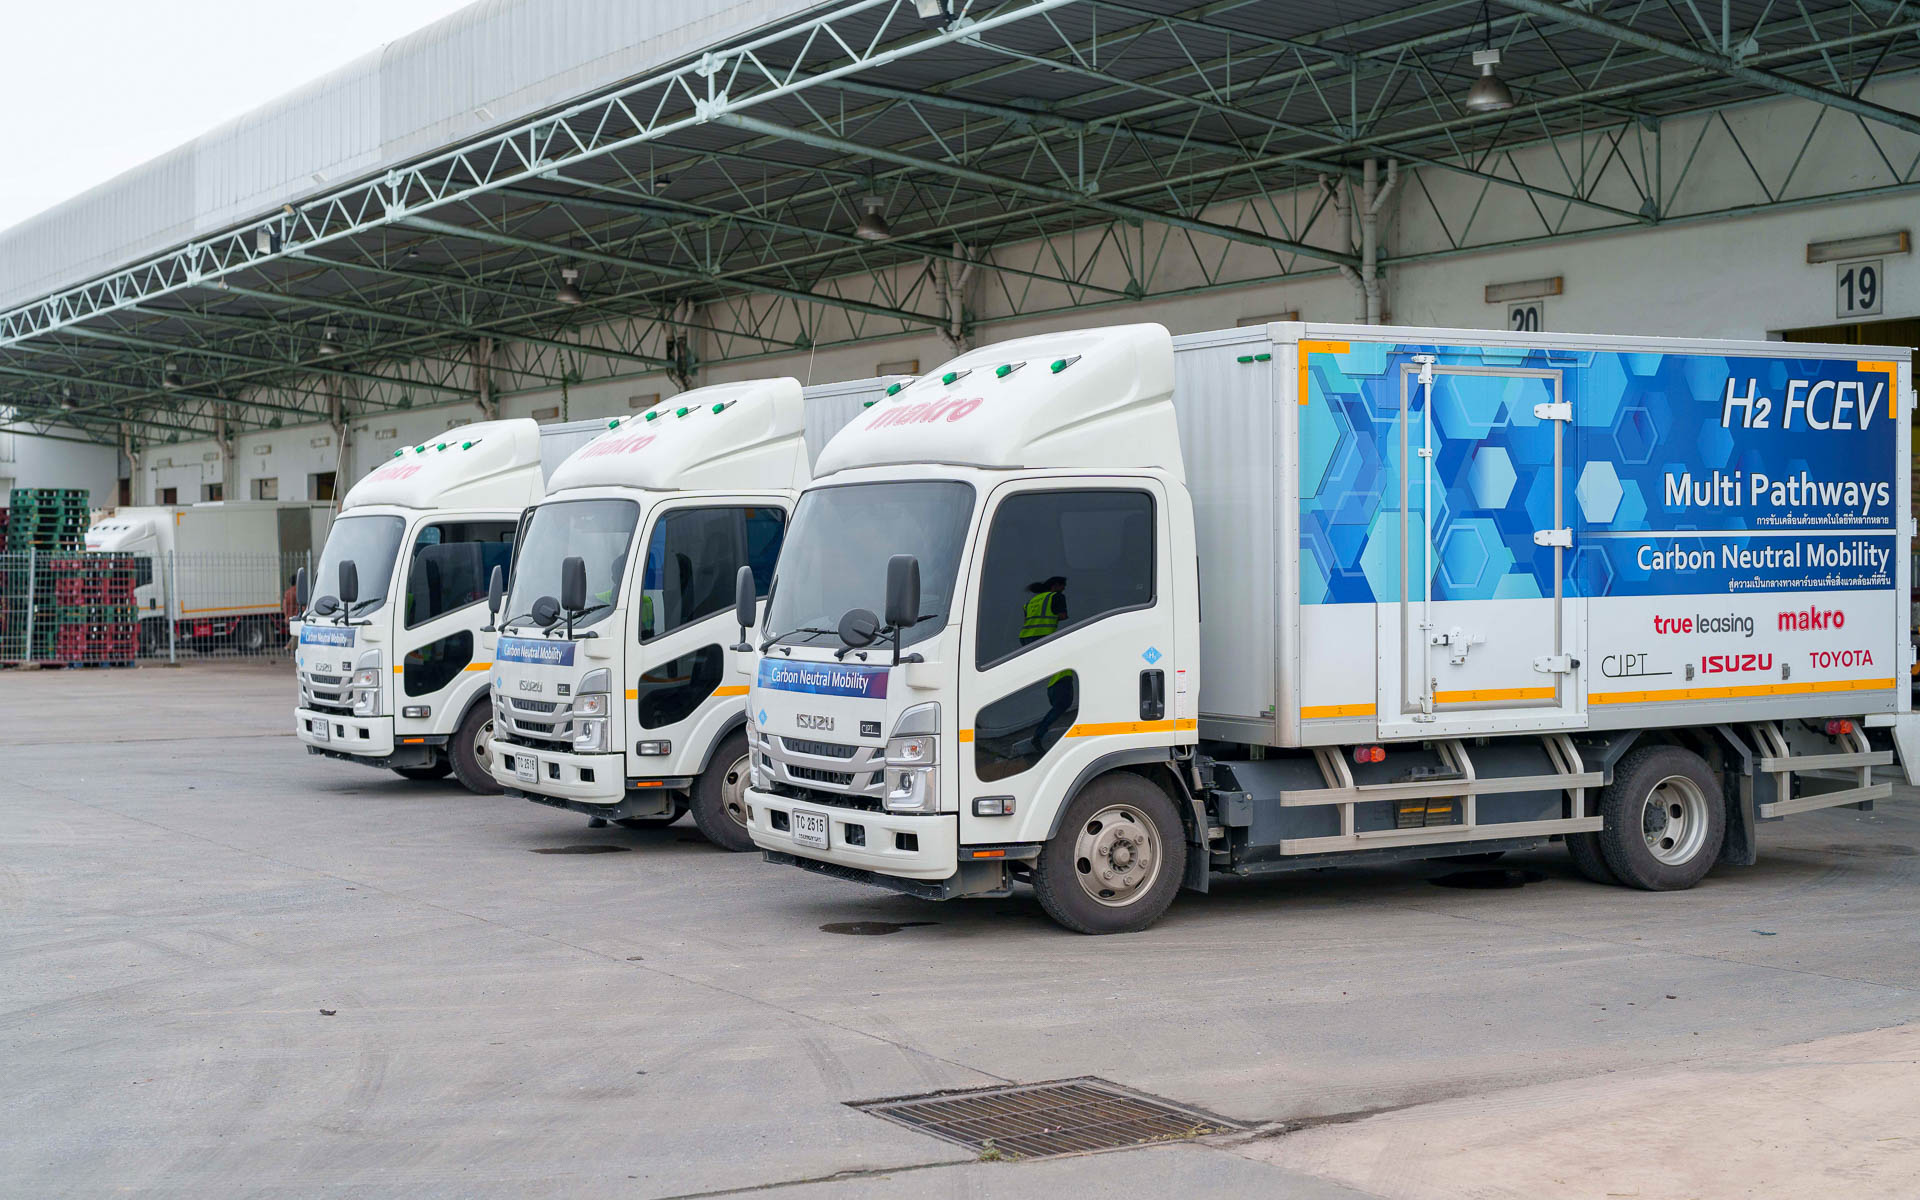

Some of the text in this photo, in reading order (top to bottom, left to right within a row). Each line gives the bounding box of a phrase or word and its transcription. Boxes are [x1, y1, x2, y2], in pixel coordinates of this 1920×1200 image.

[1840, 266, 1876, 311] 19
[1512, 306, 1538, 332] 20
[864, 395, 984, 431] makro
[1721, 377, 1884, 431] H2 FCEV
[1664, 470, 1890, 516] Multi Pathways
[1636, 541, 1890, 573] Carbon Neutral Mobility
[1653, 613, 1754, 638] true leasing
[1778, 605, 1845, 631] makro
[504, 643, 562, 664] Carbon Neutral Mobility
[1702, 653, 1773, 674] ISUZU
[1809, 650, 1874, 669] TOYOTA
[771, 667, 869, 694] Carbon Neutral Mobility
[796, 713, 835, 731] ISUZU
[795, 814, 824, 833] TC 2515
